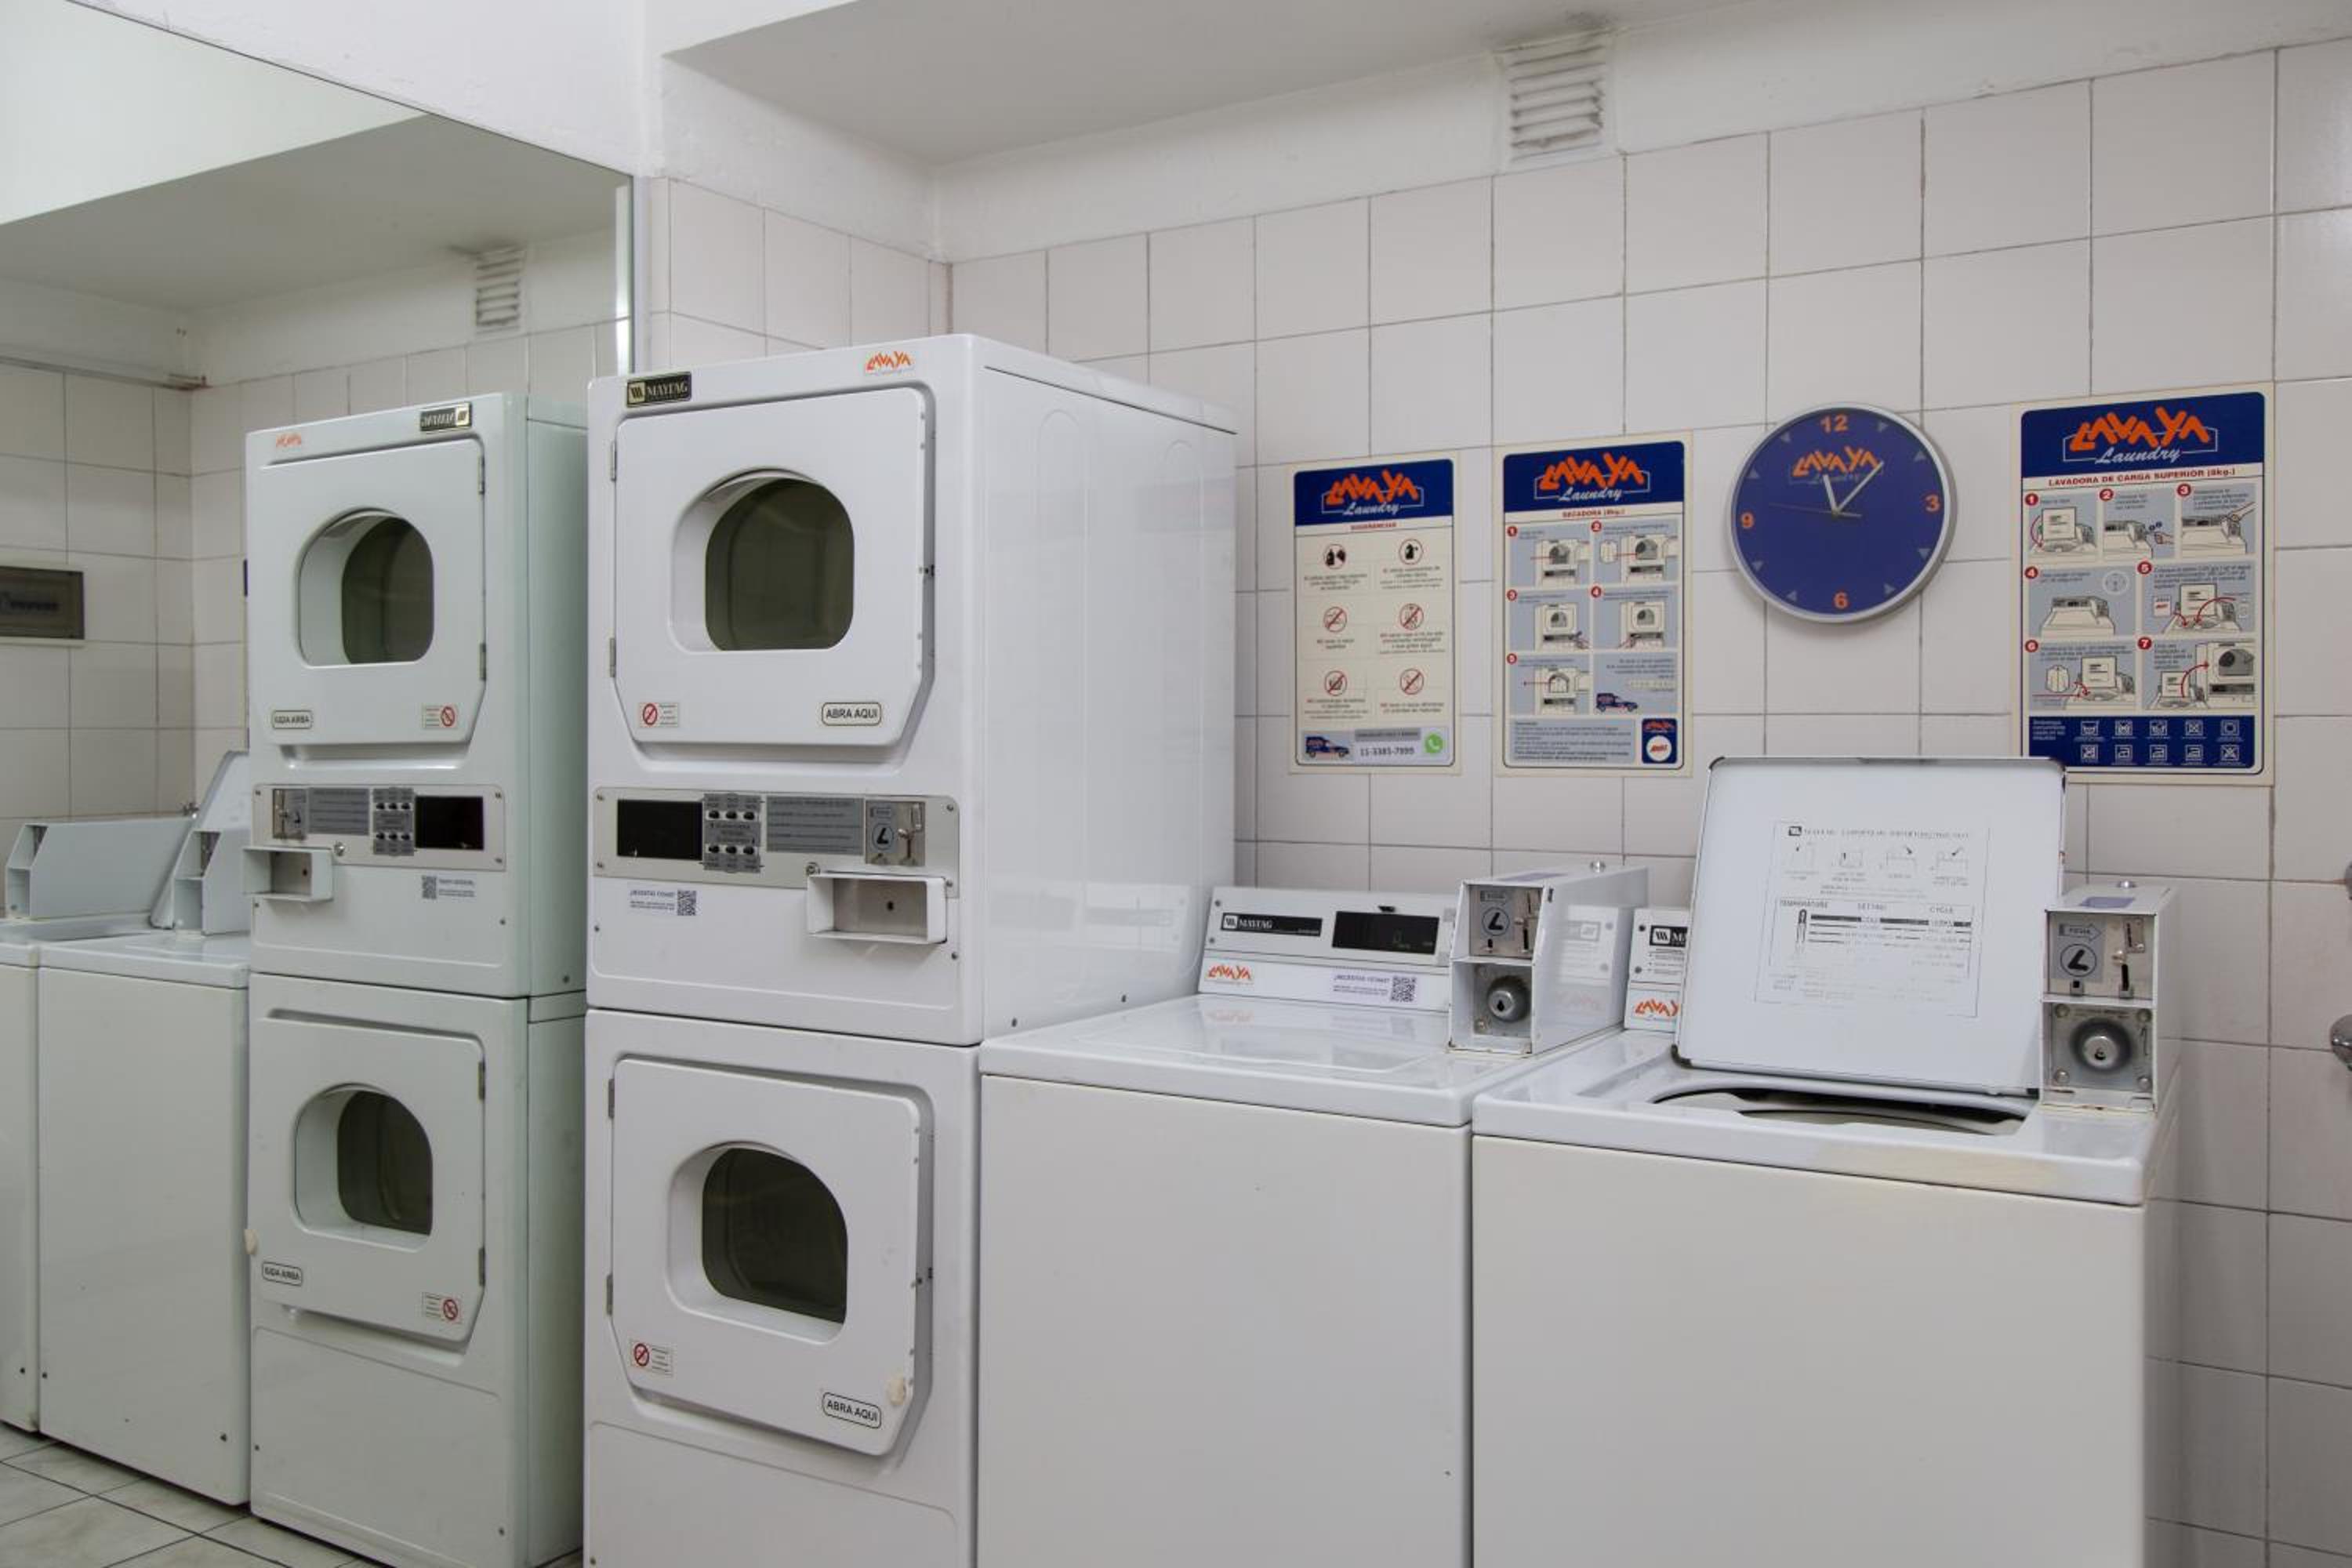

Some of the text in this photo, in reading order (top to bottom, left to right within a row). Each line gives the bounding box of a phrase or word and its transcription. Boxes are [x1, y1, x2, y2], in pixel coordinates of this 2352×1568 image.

[647, 381, 688, 397] MAYTAG
[1820, 414, 1849, 434] 12
[2070, 406, 2210, 452] LAVAYA
[1792, 445, 1880, 477] LAVAYA
[2095, 446, 2182, 464] Laundry
[1540, 452, 1645, 491] LAVAYA
[2049, 477, 2100, 486] LAVADORA
[2117, 474, 2151, 482] CARGA
[2154, 470, 2204, 479] SUPERIOR
[1326, 468, 1419, 506] LAVAYA
[1558, 486, 1623, 502] Laundry
[1343, 502, 1400, 516] Laundry
[1926, 494, 1940, 512] 3
[1740, 512, 1755, 529] 9
[1833, 591, 1849, 609] 6
[826, 709, 878, 720] ABRA AQUI
[1239, 918, 1272, 929] MAYTAG
[1207, 964, 1251, 980] LAVAYA
[1635, 999, 1679, 1017] LAVAY
[827, 1399, 878, 1422] ABRA AQUI
